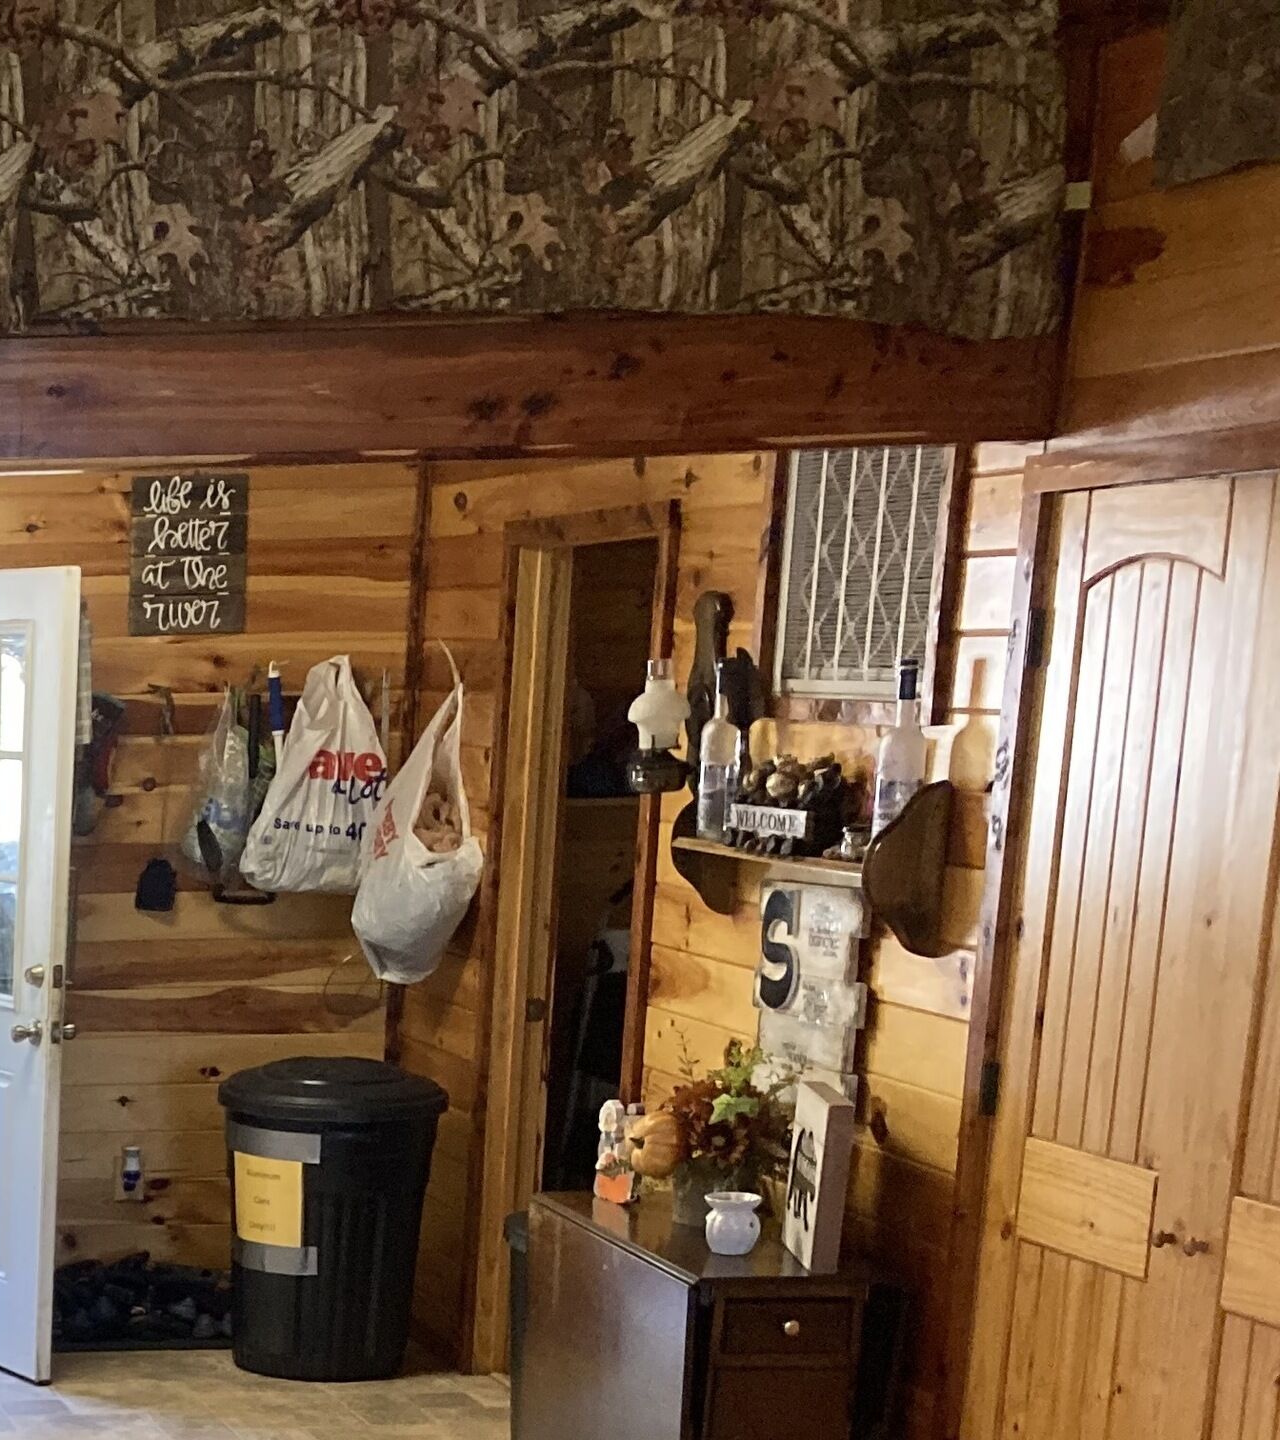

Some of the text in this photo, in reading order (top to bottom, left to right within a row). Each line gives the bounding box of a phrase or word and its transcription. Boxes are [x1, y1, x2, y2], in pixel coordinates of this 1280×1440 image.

[143, 476, 236, 514] life is
[148, 516, 229, 552] better
[142, 560, 176, 589] at
[143, 600, 221, 631] river
[734, 808, 798, 832] WELCOME
[760, 889, 794, 1010] S
